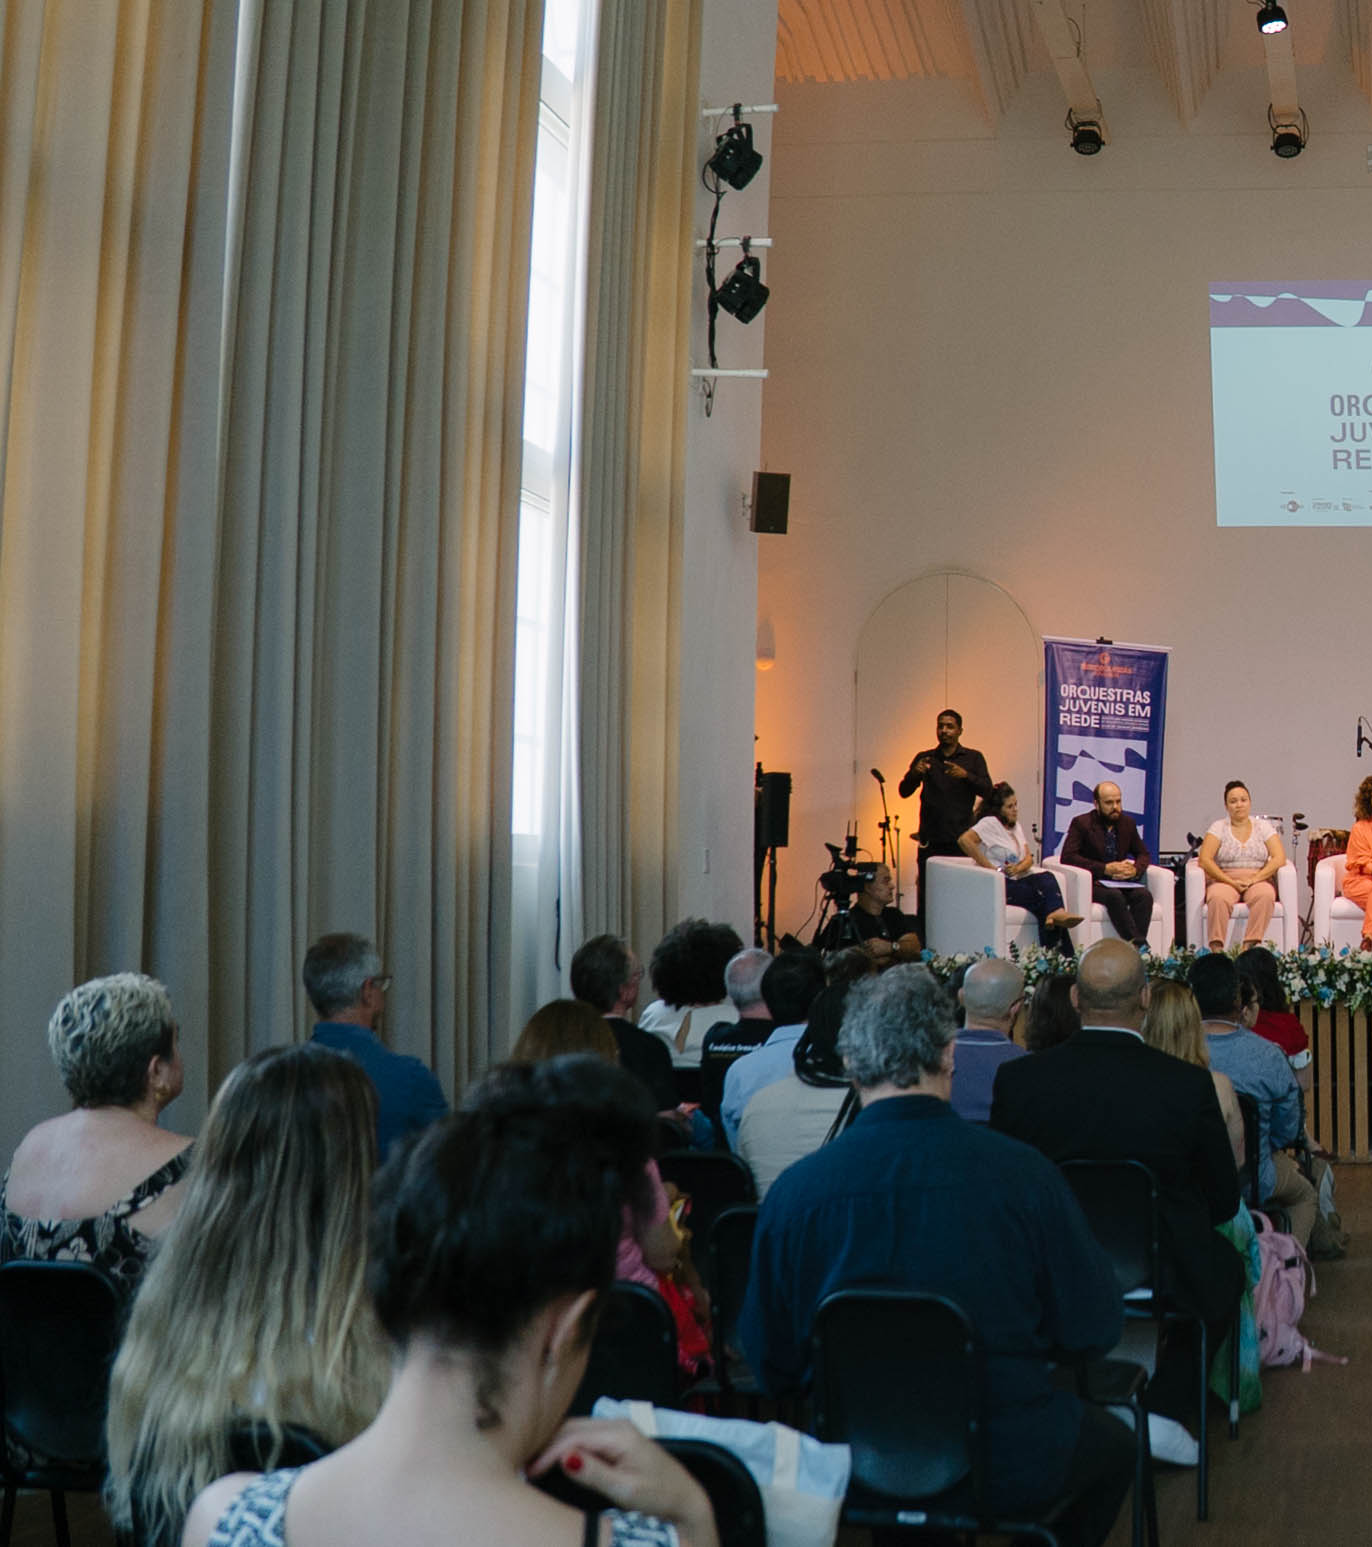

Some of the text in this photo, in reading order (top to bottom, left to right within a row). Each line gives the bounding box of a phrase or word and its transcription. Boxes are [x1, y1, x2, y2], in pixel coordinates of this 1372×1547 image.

[1060, 684, 1151, 704] ORQUESTRAS
[1059, 698, 1151, 718] JUVENIS EM
[1059, 712, 1100, 728] REDE
